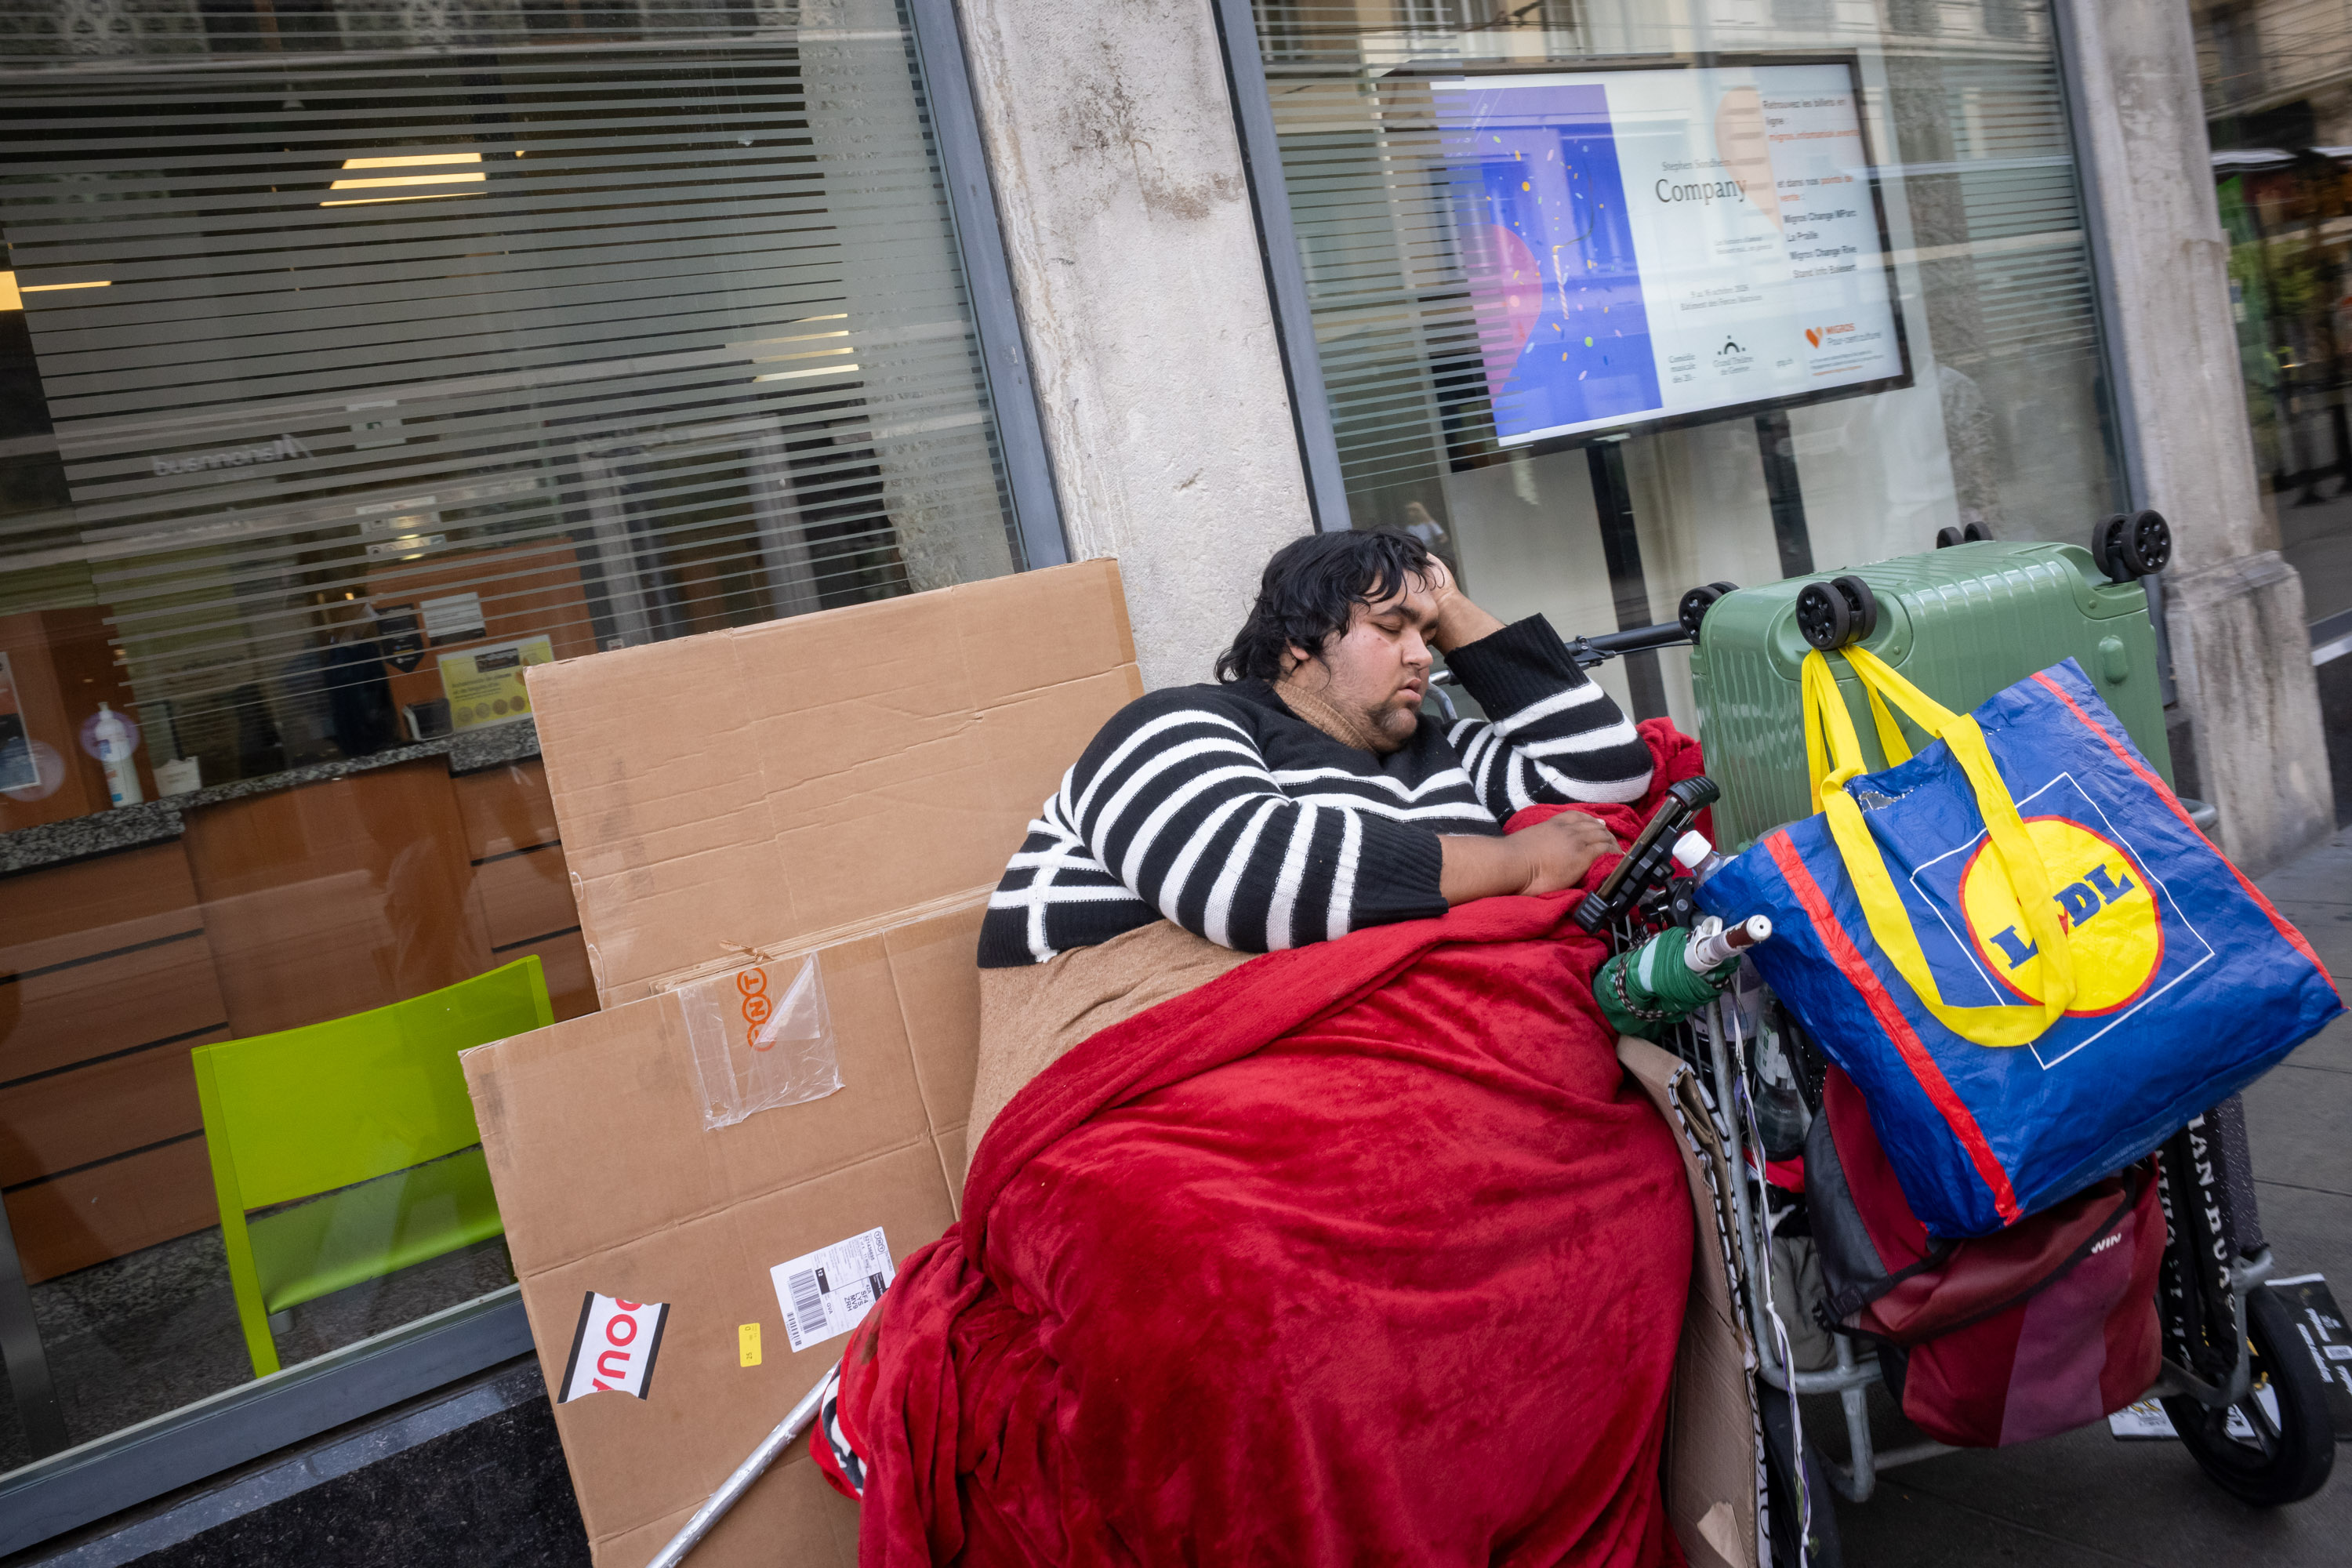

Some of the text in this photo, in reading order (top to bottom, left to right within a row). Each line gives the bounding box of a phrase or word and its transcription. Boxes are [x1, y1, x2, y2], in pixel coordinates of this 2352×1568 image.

[1656, 179, 1747, 205] Company
[1989, 863, 2135, 970] LDL
[737, 967, 776, 1052] NT
[874, 1231, 885, 1252] TNT
[2091, 1232, 2122, 1254] WIN
[844, 1298, 853, 1312] ZRH
